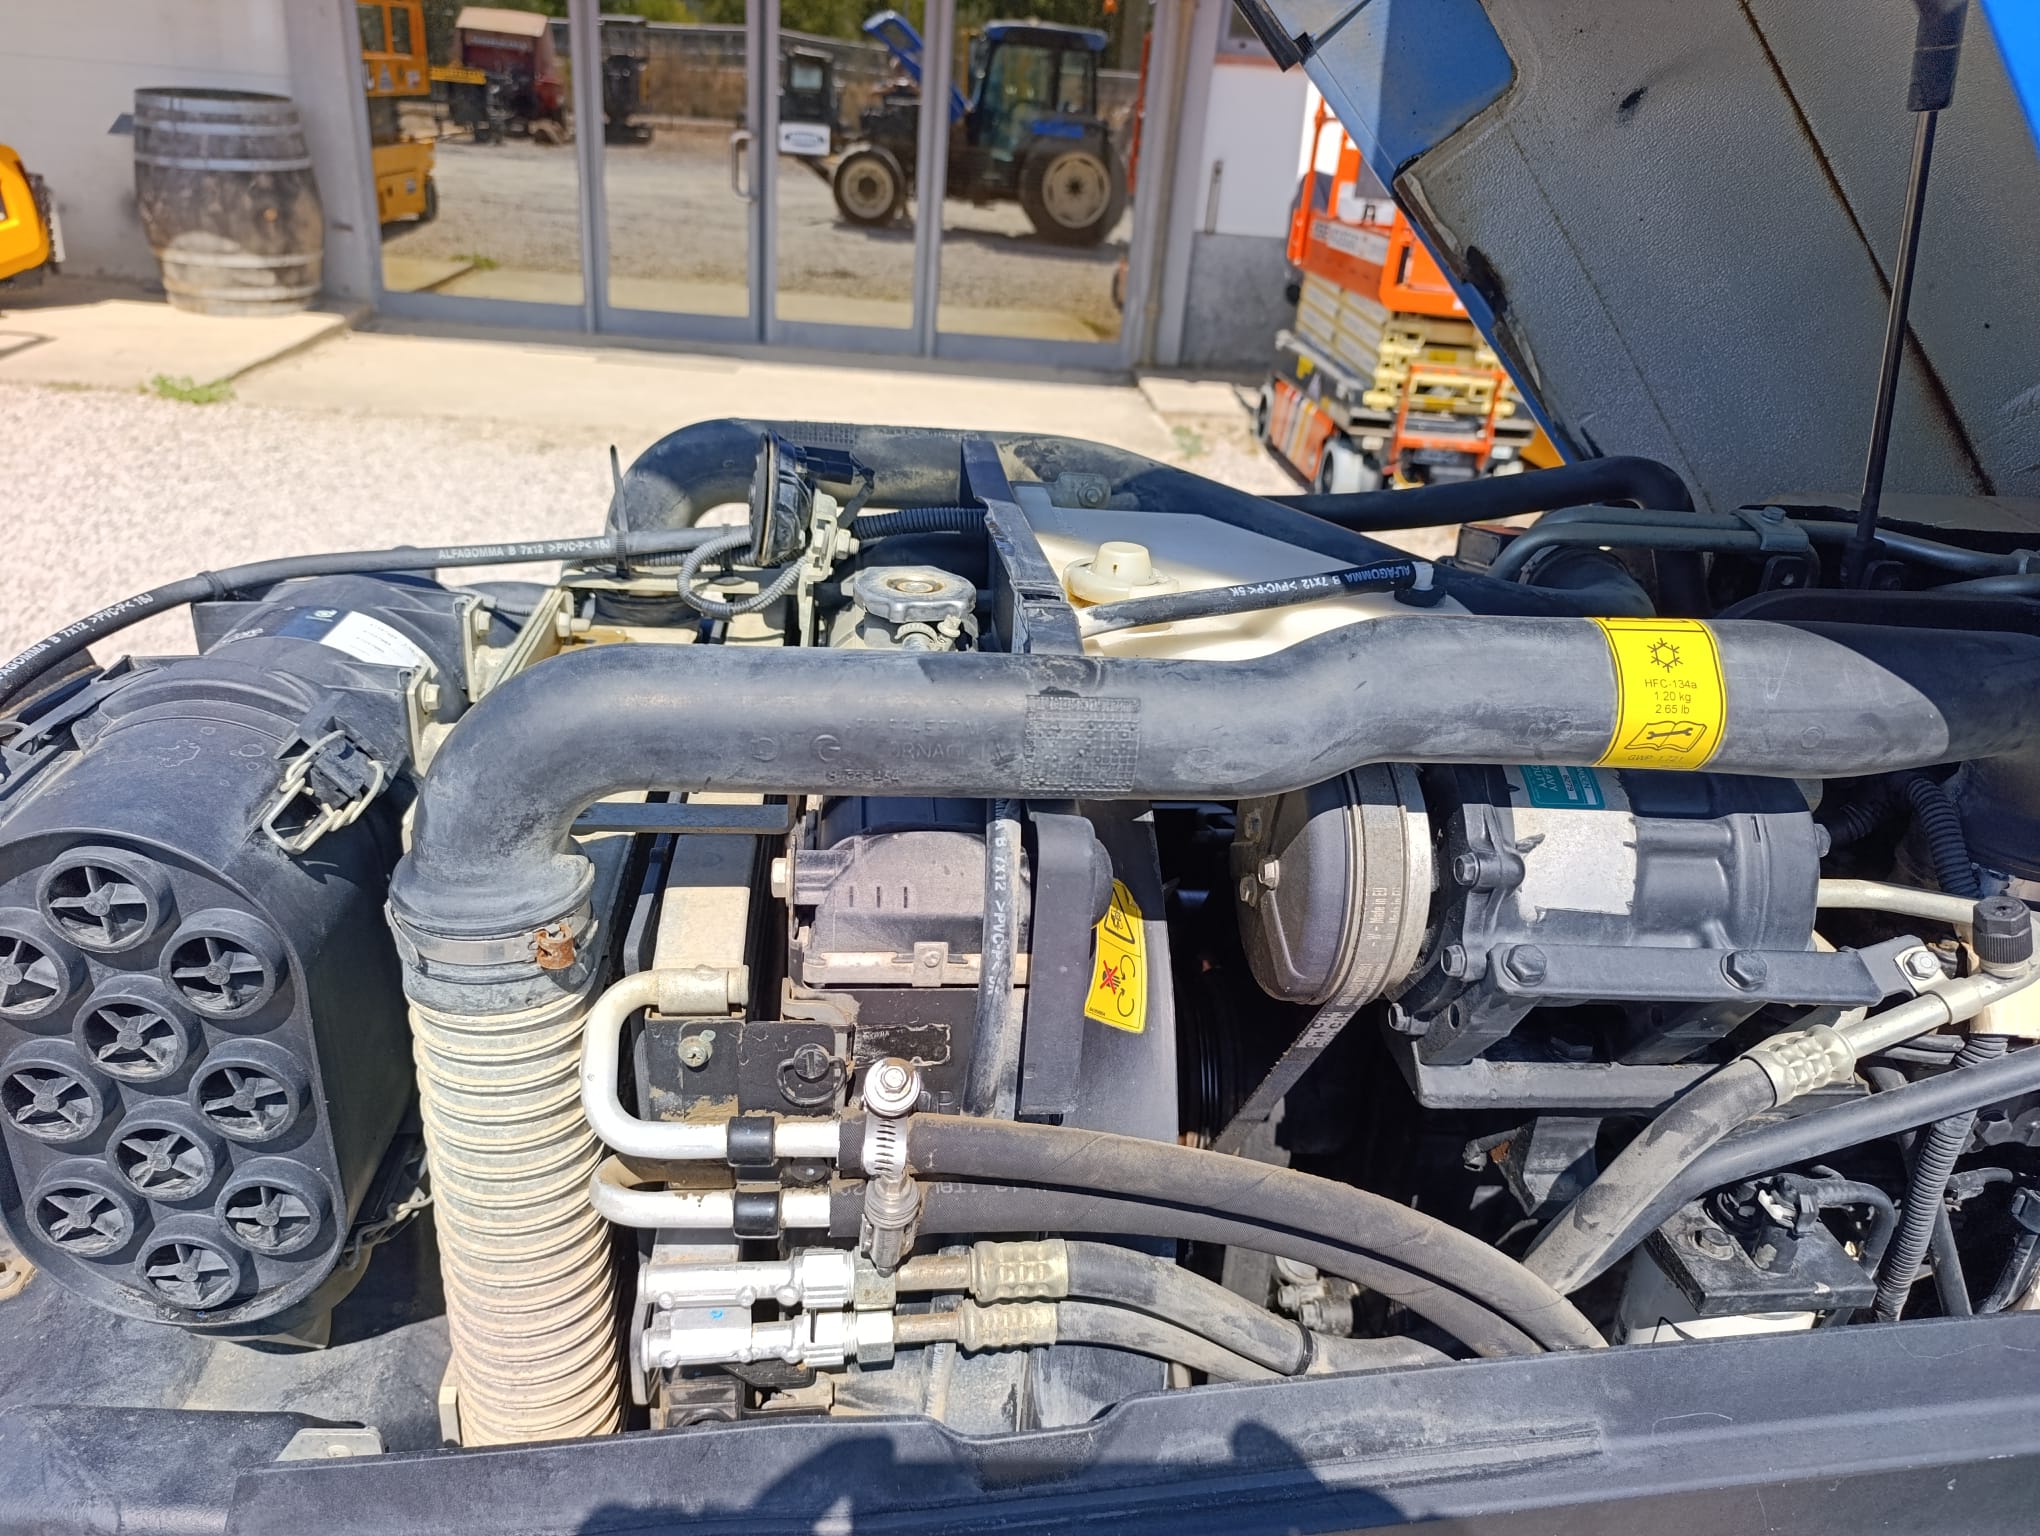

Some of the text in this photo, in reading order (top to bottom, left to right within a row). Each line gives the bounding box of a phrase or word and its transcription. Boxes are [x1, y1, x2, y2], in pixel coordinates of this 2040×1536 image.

[439, 546, 504, 560] ALFAGOMMA
[508, 545, 517, 556] B
[1345, 565, 1411, 583] ALFAGOMMA
[1333, 575, 1342, 585] B
[47, 635, 62, 645] B
[1644, 679, 1698, 689] HFC-134a
[1679, 691, 1692, 703] kg
[1680, 704, 1690, 714] lb
[995, 836, 1006, 848] B
[1373, 897, 1386, 905] in
[1371, 906, 1386, 924] Made
